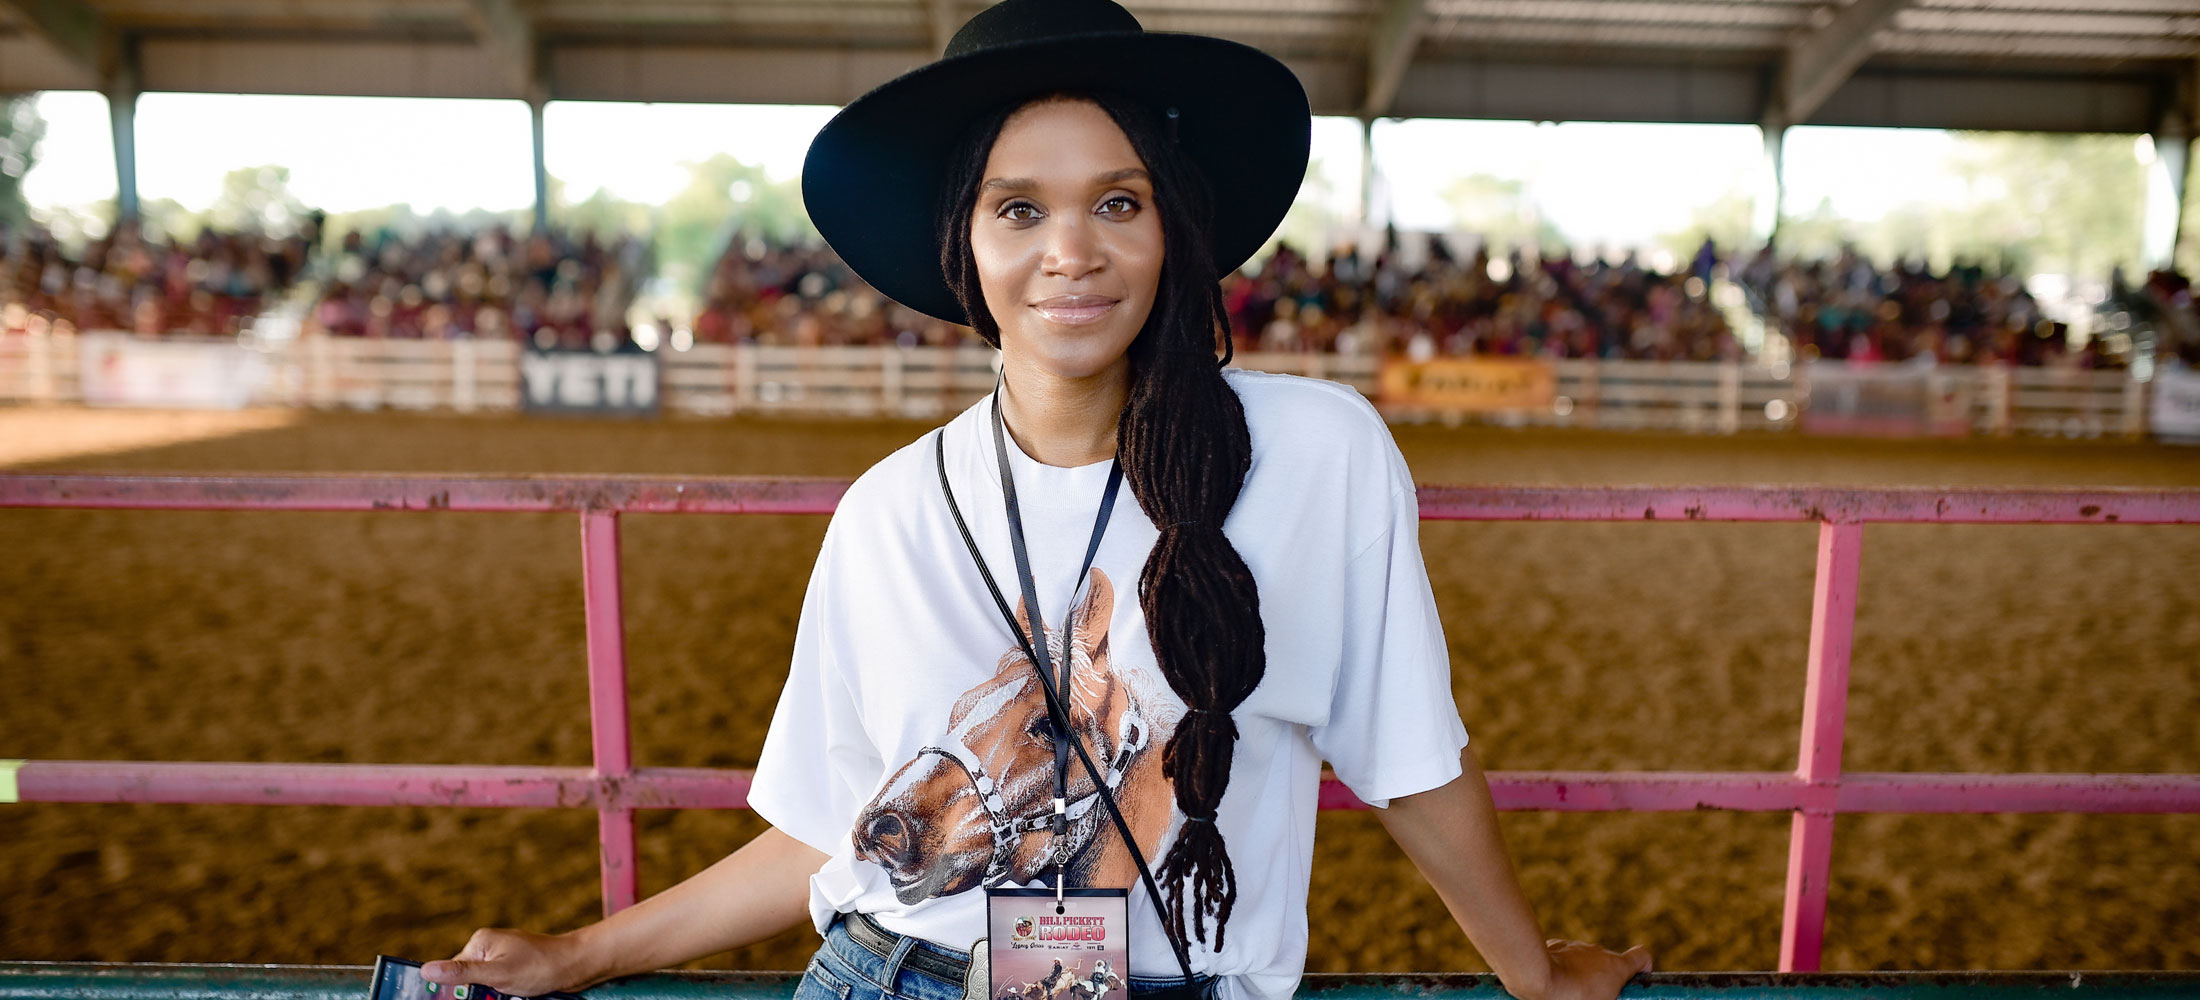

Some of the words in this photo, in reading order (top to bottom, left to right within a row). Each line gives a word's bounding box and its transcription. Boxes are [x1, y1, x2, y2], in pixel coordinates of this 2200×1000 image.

[523, 354, 657, 406] YETI
[1039, 916, 1062, 925] BILL
[1063, 916, 1104, 925] PICKETT
[1039, 926, 1105, 941] RODEO
